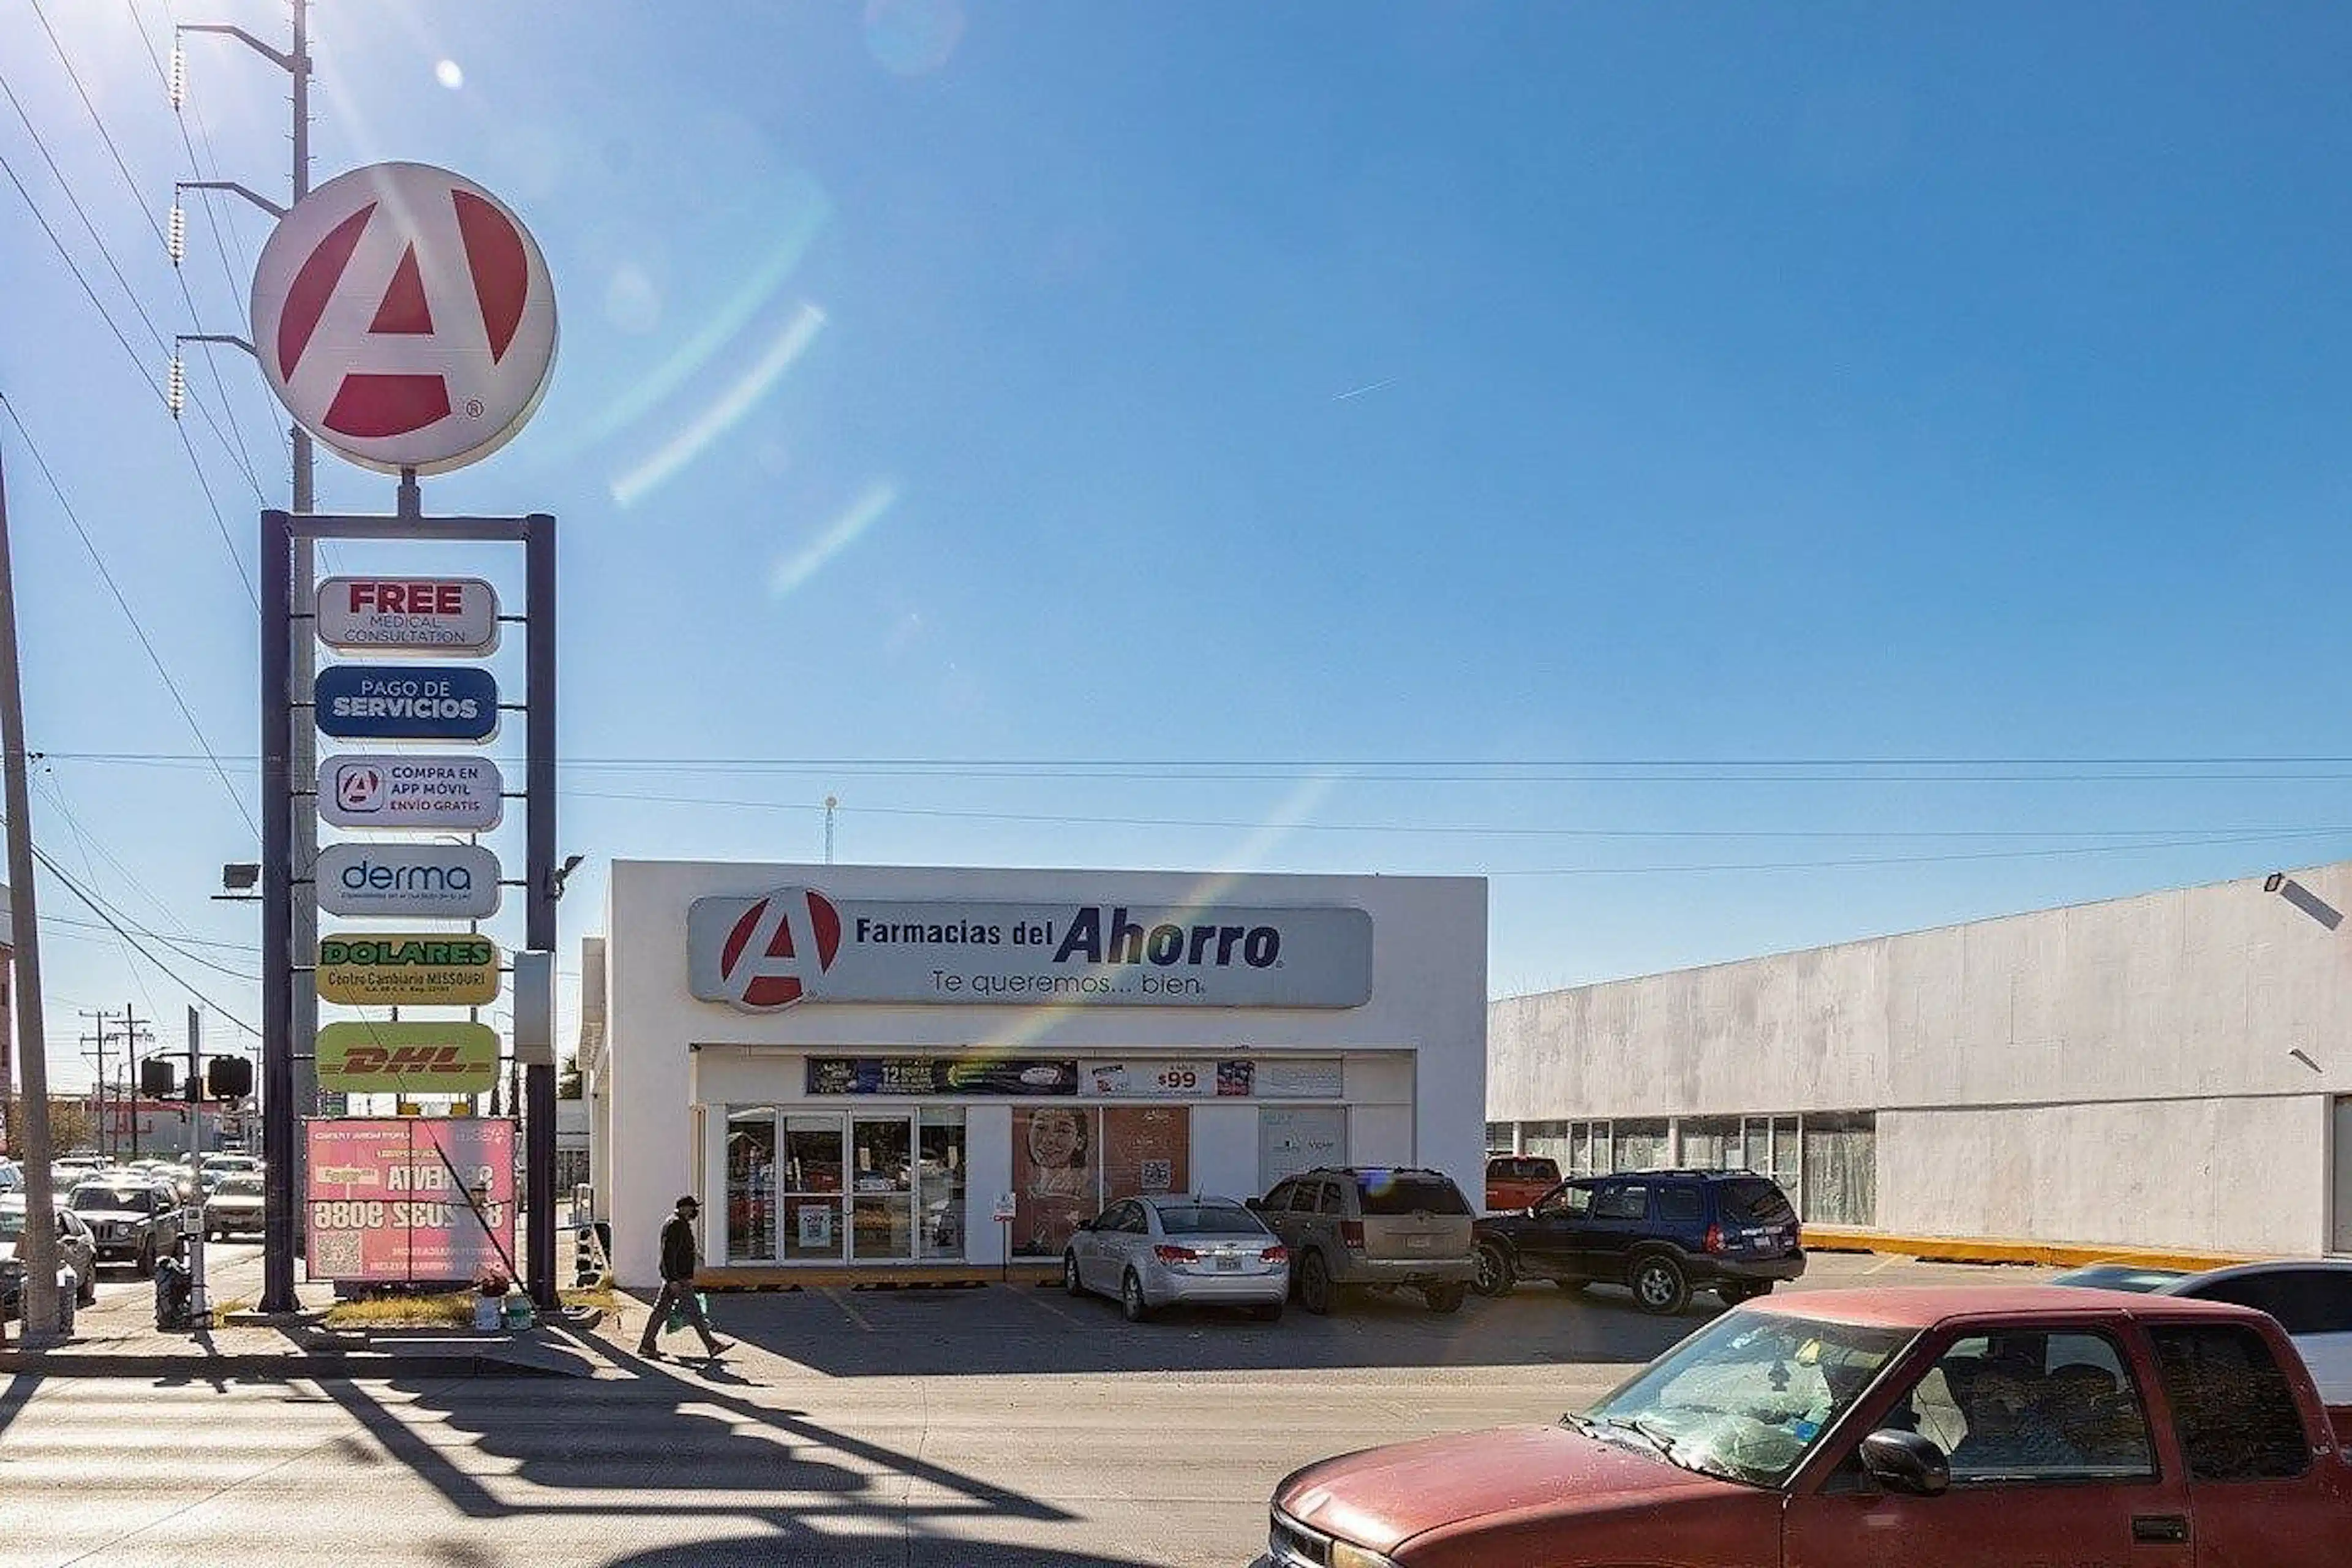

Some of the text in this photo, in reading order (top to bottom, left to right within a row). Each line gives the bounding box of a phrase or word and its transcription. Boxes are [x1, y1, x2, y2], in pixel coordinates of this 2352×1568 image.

[350, 584, 462, 614] FREE
[369, 616, 442, 628] MEDICAL
[344, 629, 466, 643] CONSULTATION
[361, 680, 451, 697] PAGO DE
[332, 698, 479, 719] SERVICIOS
[392, 767, 478, 778] COMPRA EN
[392, 780, 470, 795] APP MÓVIL
[434, 800, 480, 810] GRATIS
[342, 861, 472, 890] derma
[857, 907, 1280, 968] Farmacias del Ahorro
[322, 941, 492, 965] DOLARES
[328, 973, 365, 986] Centro
[428, 973, 485, 986] MISSOURI
[933, 971, 962, 992] Te
[971, 974, 1131, 998] queremos...
[342, 1047, 467, 1073] DHL
[1158, 1072, 1196, 1088] $99
